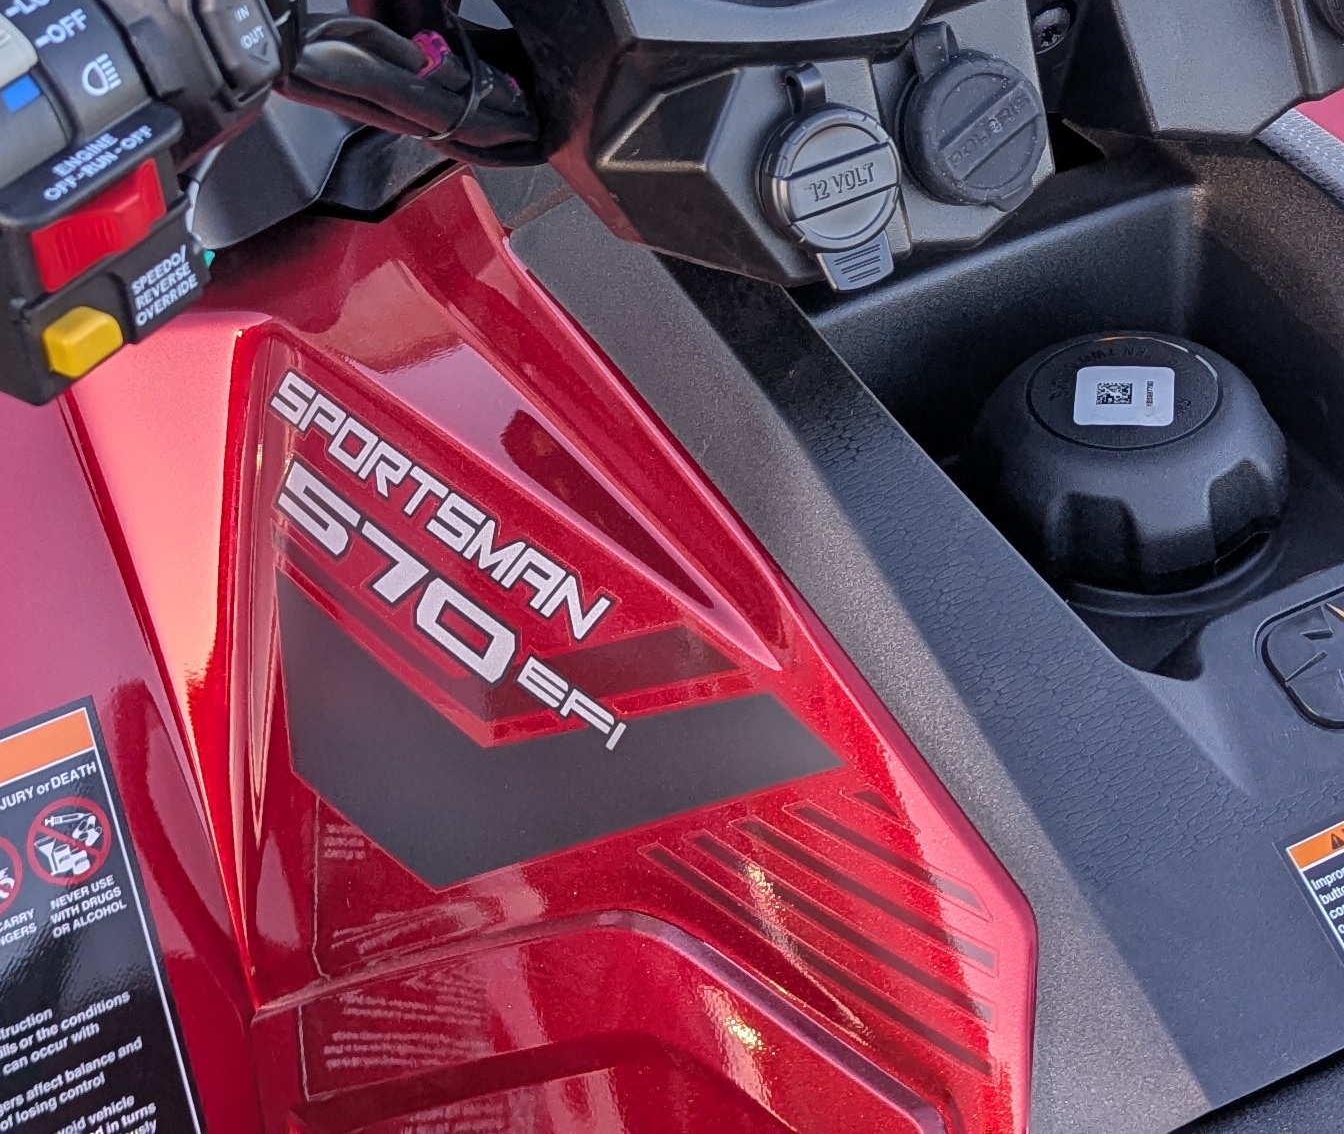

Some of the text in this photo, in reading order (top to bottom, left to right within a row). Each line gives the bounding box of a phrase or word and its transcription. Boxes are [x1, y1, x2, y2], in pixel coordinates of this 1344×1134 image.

[235, 5, 250, 22] IN
[241, 25, 264, 49] OUT
[52, 133, 119, 177] ENGINE
[809, 162, 875, 202] 12 VOLT
[135, 261, 192, 311] REVERSE
[135, 273, 198, 326] OVERRIDE
[270, 371, 611, 640] SPORTSMAN
[278, 461, 517, 684] 570
[518, 655, 627, 750] EFI
[36, 782, 50, 795] or
[50, 761, 96, 789] DEATH
[49, 886, 121, 924] WITH DRUGS
[50, 874, 114, 910] NEVER USE
[52, 899, 127, 938] OR ALCOHOL
